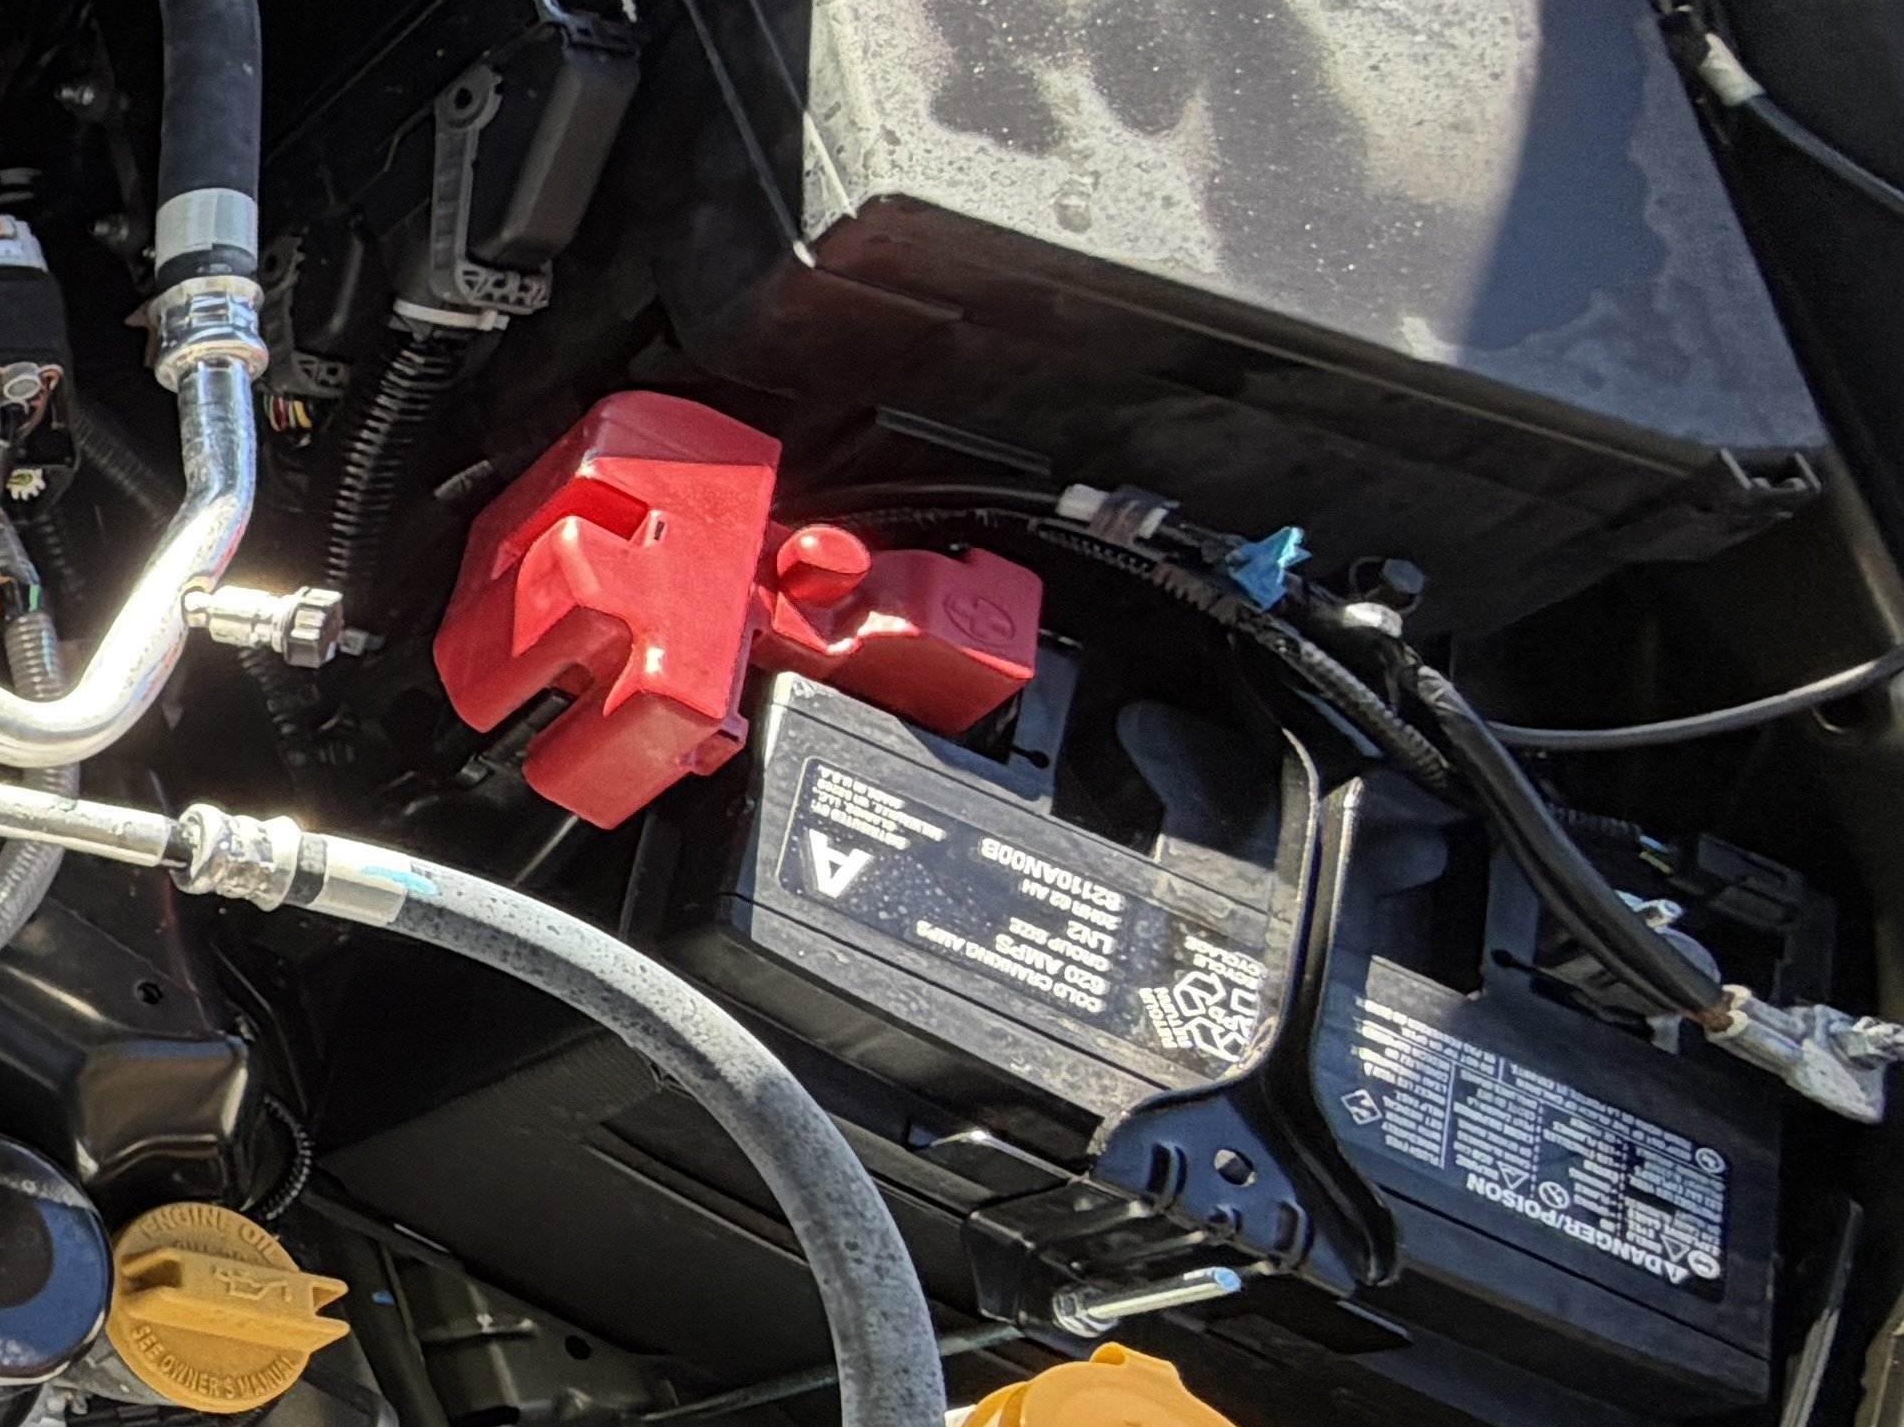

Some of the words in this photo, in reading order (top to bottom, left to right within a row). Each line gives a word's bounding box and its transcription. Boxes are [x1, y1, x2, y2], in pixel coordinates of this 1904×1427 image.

[1017, 876, 1051, 902] AH
[1046, 888, 1074, 912] 62
[1005, 915, 1051, 947] SIZE
[1067, 897, 1123, 933] 20HR
[911, 917, 967, 954] AMPS
[1045, 933, 1112, 974] GROUP
[1061, 918, 1118, 956] LN2
[961, 940, 1056, 993] CRANKING
[990, 931, 1066, 978] AMPS
[1050, 980, 1103, 1014] COLD
[1060, 962, 1108, 996] 620
[142, 1204, 227, 1241] ENGINE
[238, 1224, 279, 1267] OIL
[1462, 1171, 1669, 1276] DANGER/POISON
[131, 1325, 163, 1359] SEE
[236, 1353, 296, 1399] MANUAL
